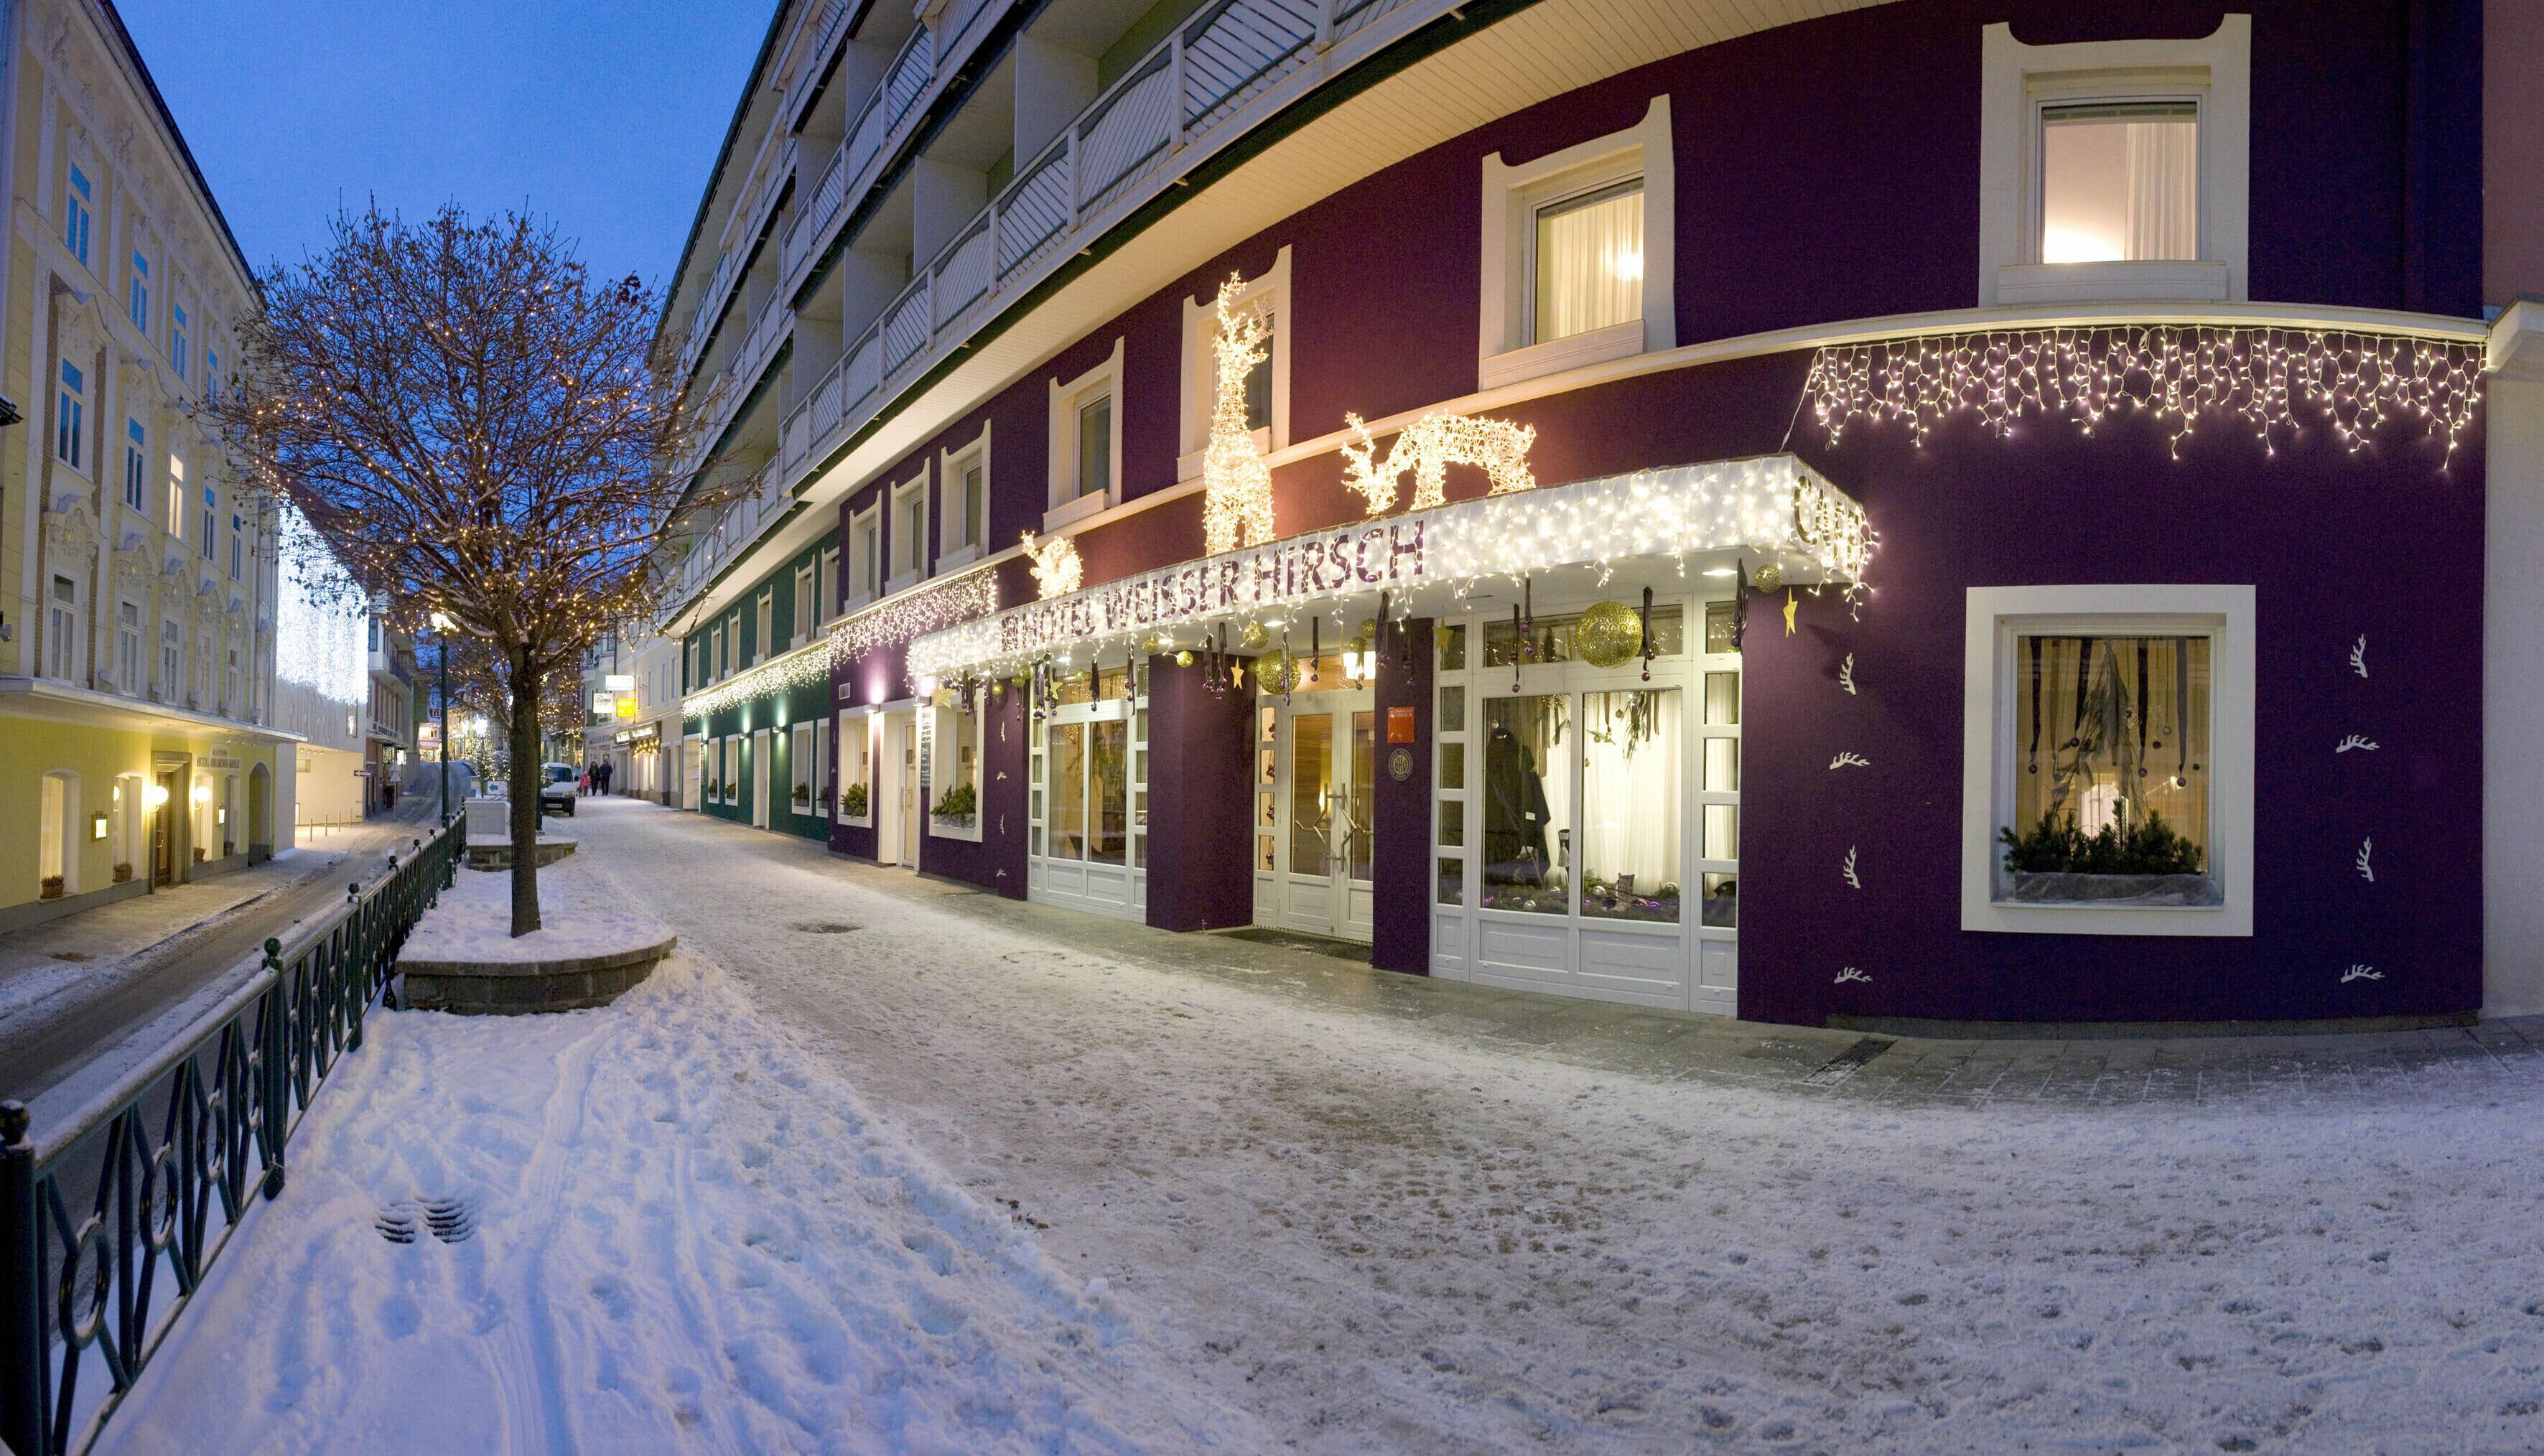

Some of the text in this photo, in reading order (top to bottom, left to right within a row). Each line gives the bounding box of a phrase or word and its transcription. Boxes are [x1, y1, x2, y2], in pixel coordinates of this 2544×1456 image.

[1022, 519, 1425, 649] HOTEL WEISSER HIRSCH
